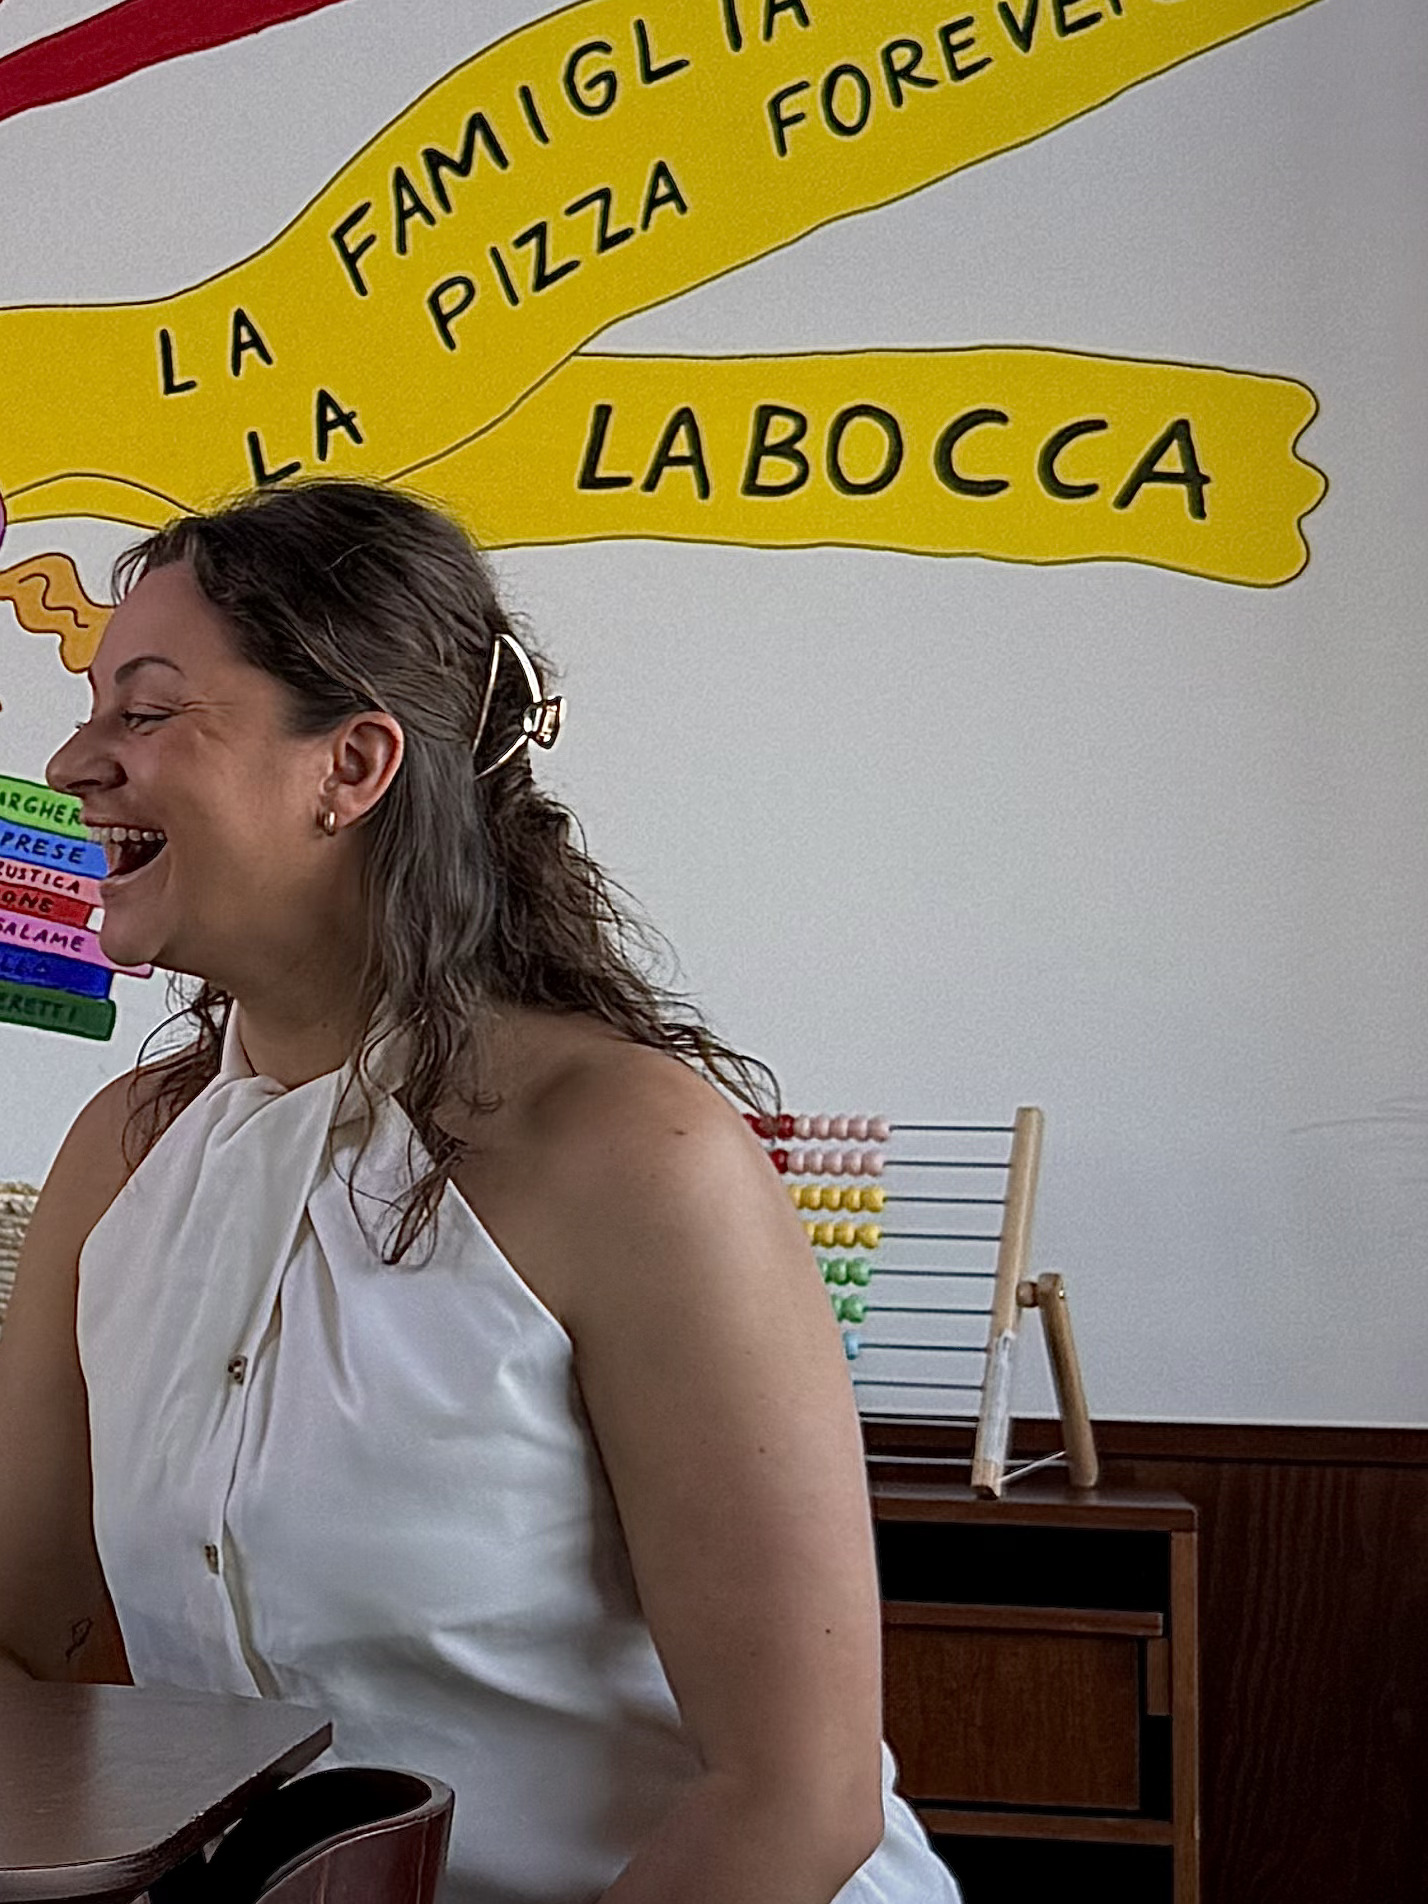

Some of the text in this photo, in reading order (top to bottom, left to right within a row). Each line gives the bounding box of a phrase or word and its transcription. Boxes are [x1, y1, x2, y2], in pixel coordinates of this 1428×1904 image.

[158, 307, 274, 397] LA
[246, 388, 364, 487] LA
[425, 159, 689, 352] PIZZA
